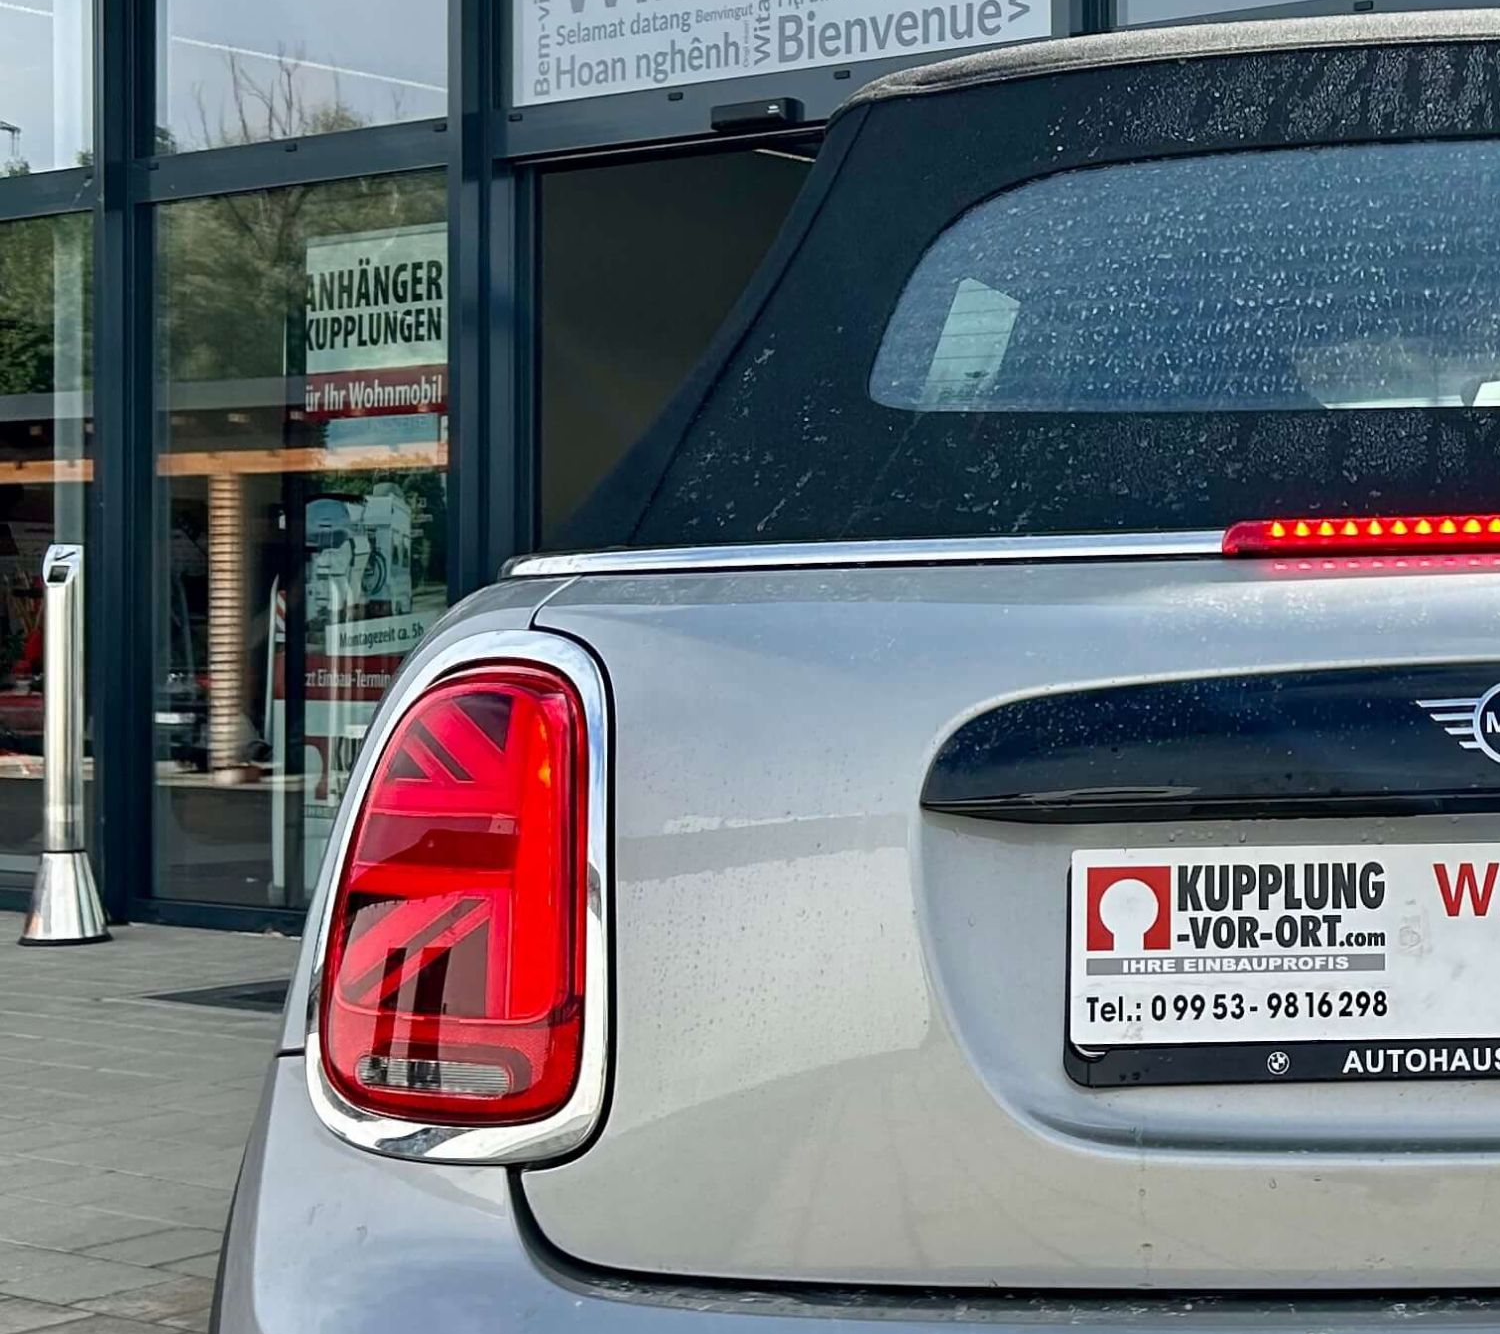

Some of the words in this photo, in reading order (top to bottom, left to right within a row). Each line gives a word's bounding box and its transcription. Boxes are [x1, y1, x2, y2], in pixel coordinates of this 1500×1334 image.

[556, 20, 625, 47] Selamat
[630, 12, 691, 36] datang
[695, 4, 754, 25] Benvingut
[556, 53, 627, 91] Hoan
[636, 31, 741, 84] nghênh
[304, 257, 443, 312] ANHÄNGER
[305, 385, 321, 413] ür
[324, 382, 347, 411] Ihr
[348, 374, 443, 410] Wohnmobil
[339, 626, 396, 649] Montagezeit
[1177, 861, 1386, 912] KUPPLUNG
[1176, 914, 1386, 950] -VOR-ORT.com
[1122, 958, 1176, 974] IHRE
[1184, 955, 1350, 973] EINBAUPROFIS
[1086, 995, 1142, 1023] Tel.:
